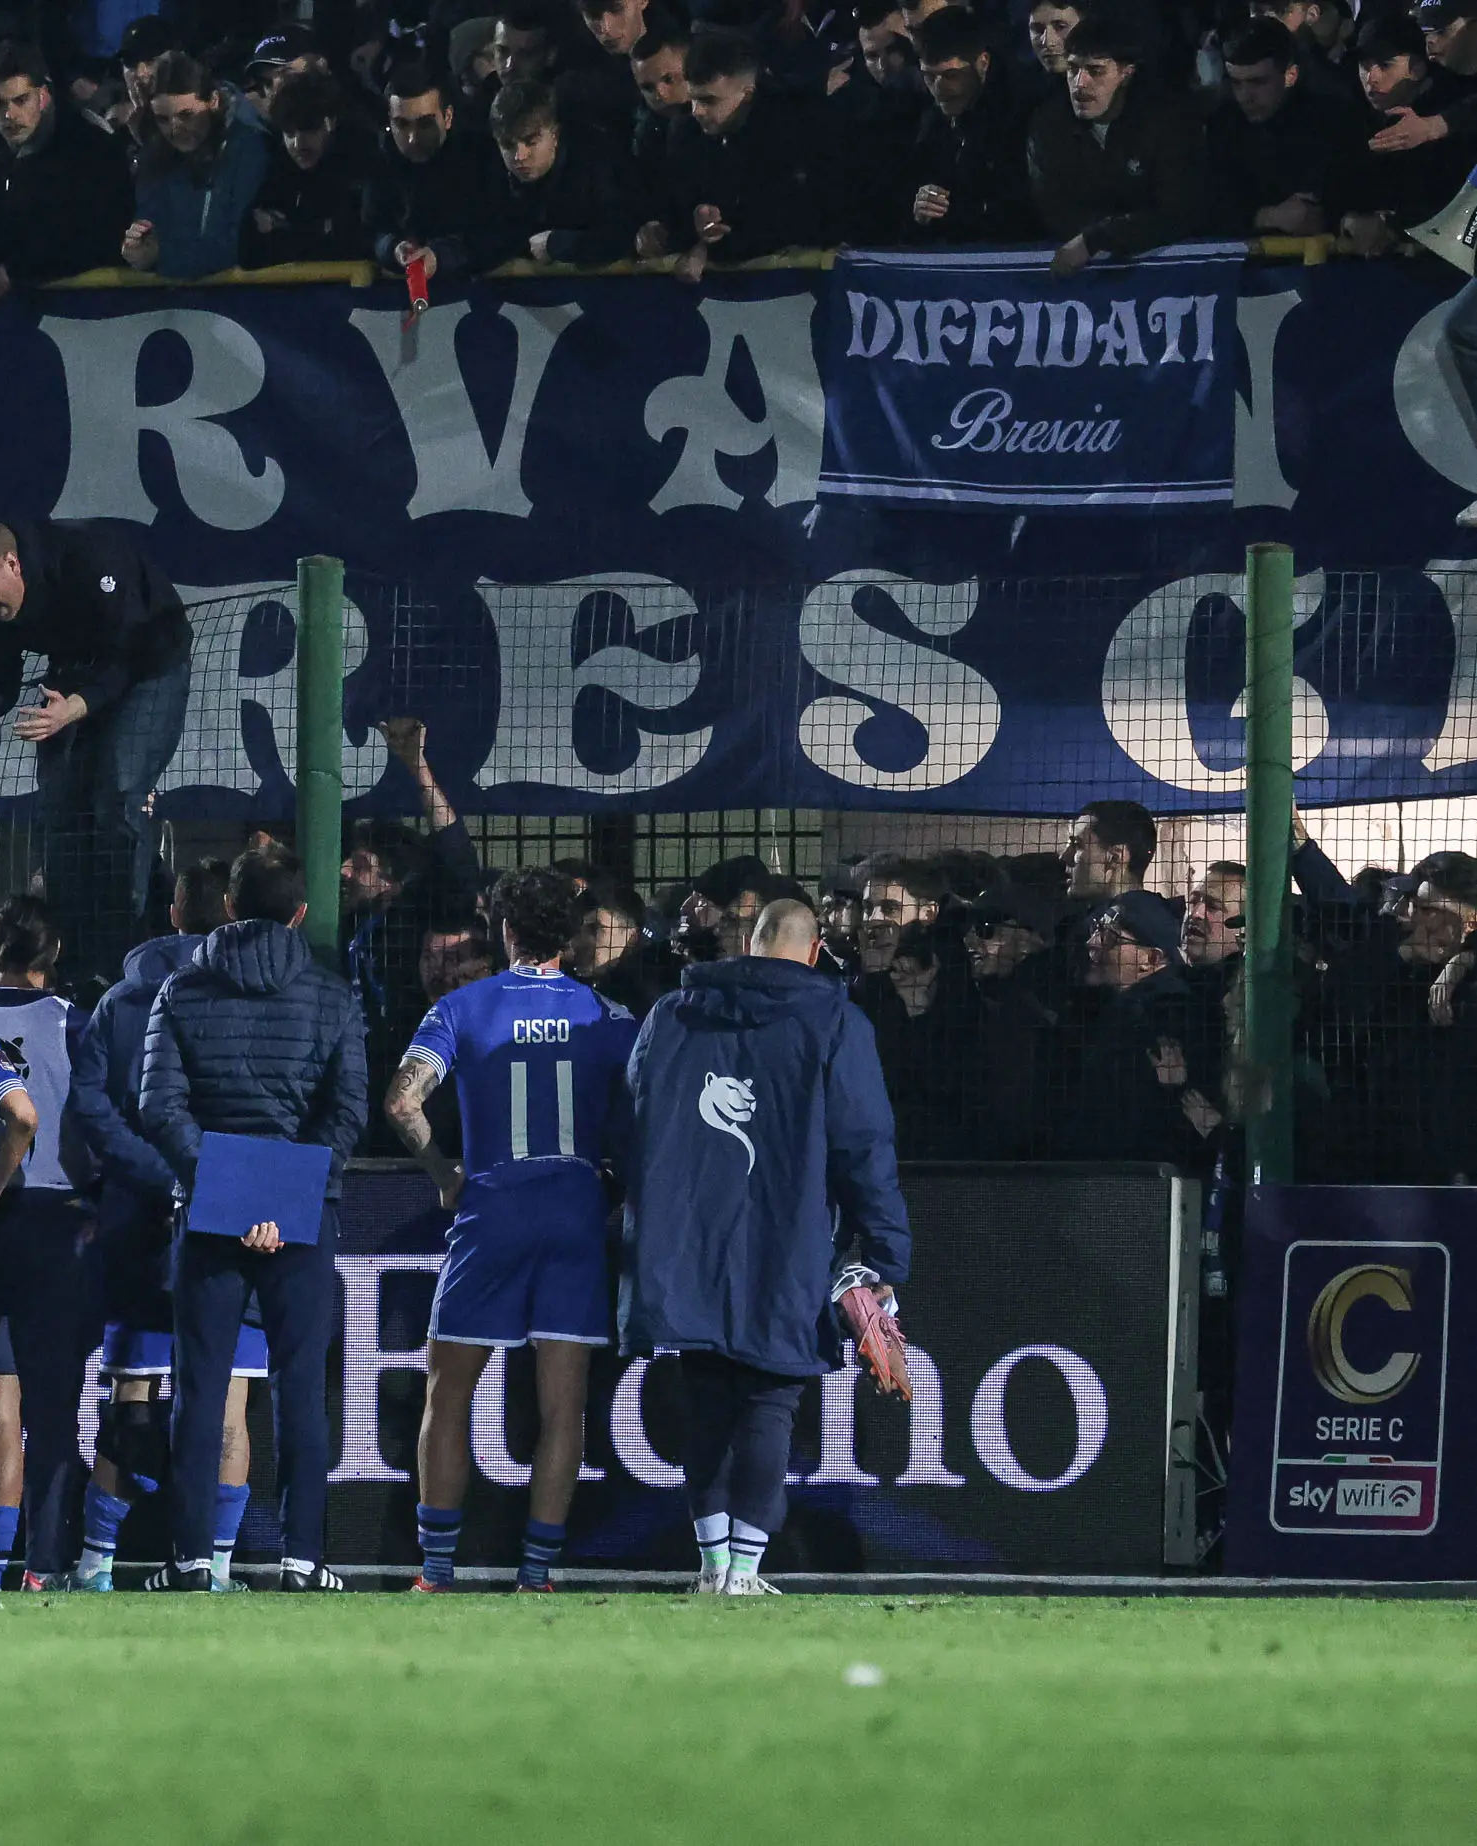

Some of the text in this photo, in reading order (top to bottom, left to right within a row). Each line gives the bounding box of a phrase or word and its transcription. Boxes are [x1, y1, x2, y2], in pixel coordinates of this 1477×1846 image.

[846, 291, 1219, 368] DIFFIDATI
[931, 388, 1121, 454] Brescia
[513, 1019, 570, 1044] CISCO
[510, 1060, 576, 1160] 11
[327, 1254, 1110, 1492] Fucno
[1315, 1417, 1404, 1442] SERIE C
[1288, 1480, 1386, 1513] sky wifi
